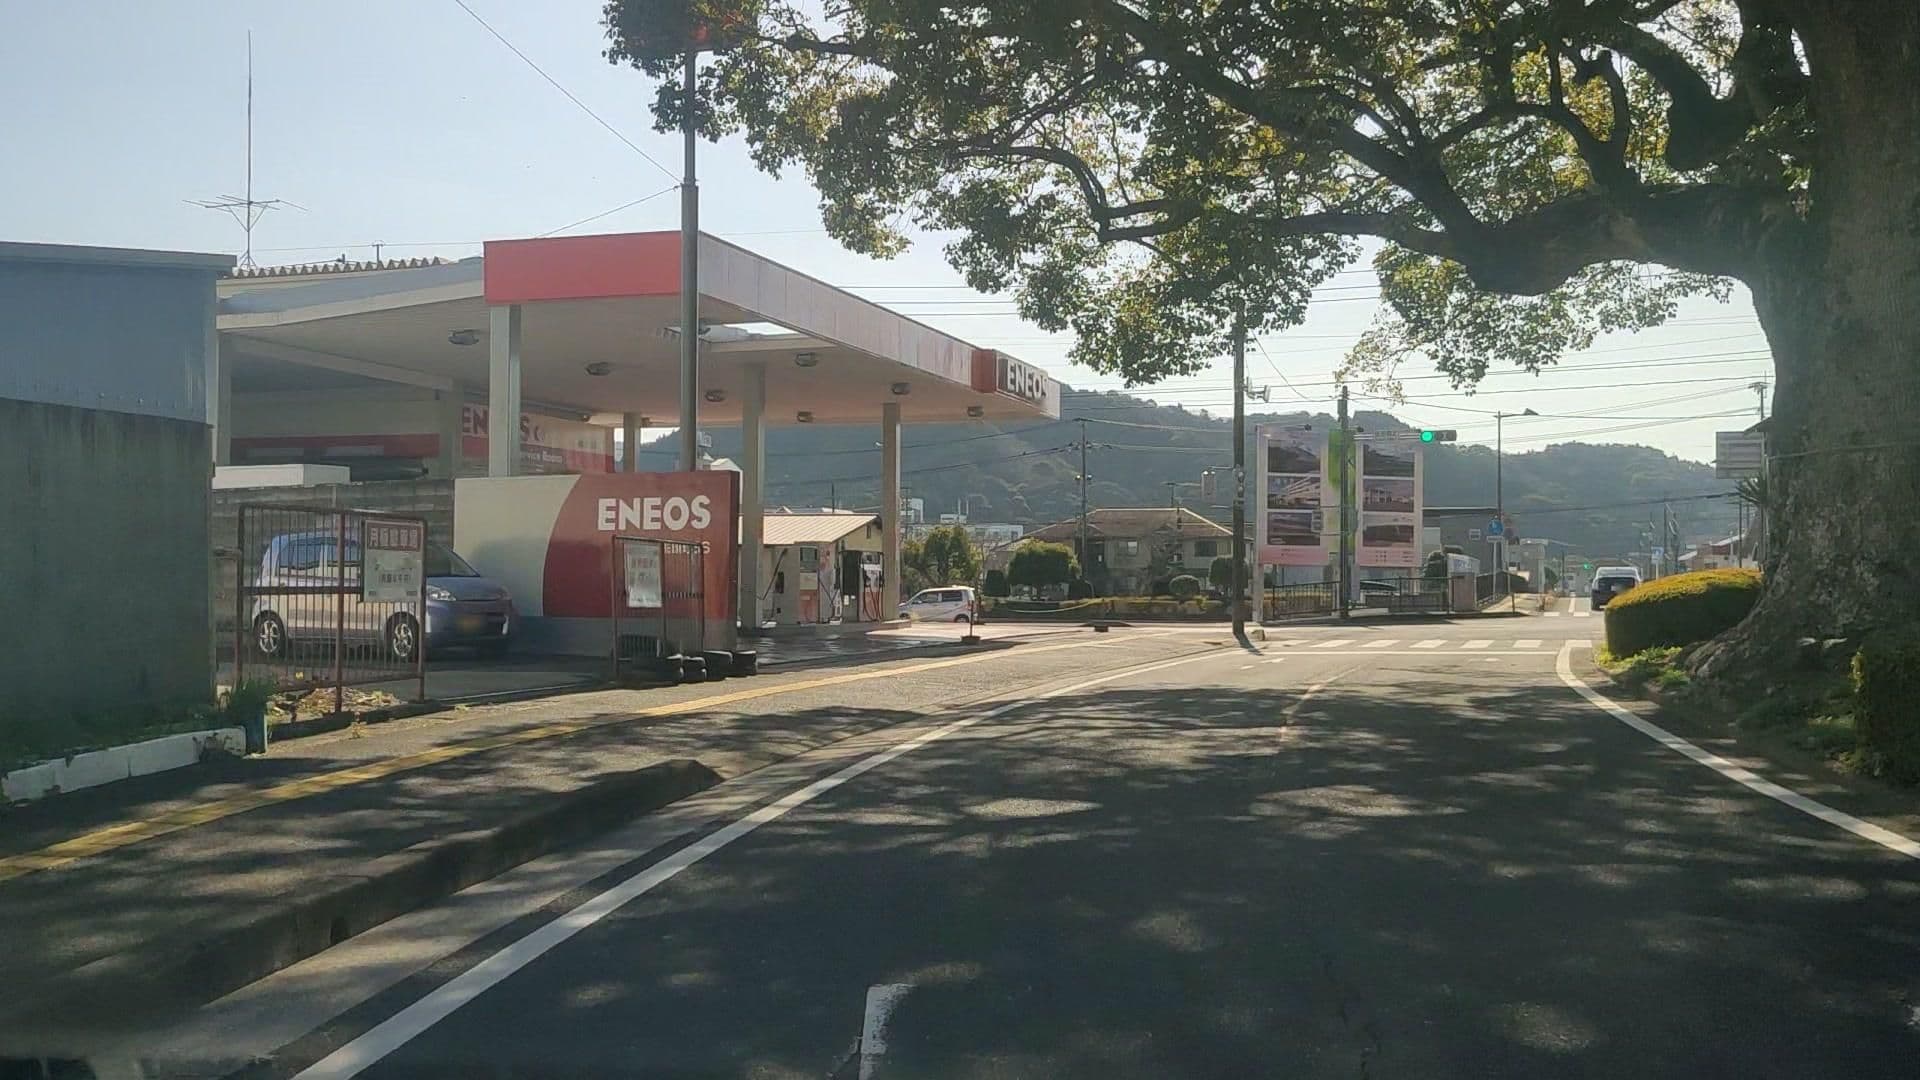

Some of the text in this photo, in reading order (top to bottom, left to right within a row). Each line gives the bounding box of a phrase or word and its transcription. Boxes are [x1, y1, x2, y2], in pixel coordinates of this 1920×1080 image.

[1007, 362, 1048, 400] ENEOS
[462, 406, 530, 441] ENS
[598, 495, 711, 531] ENEOS
